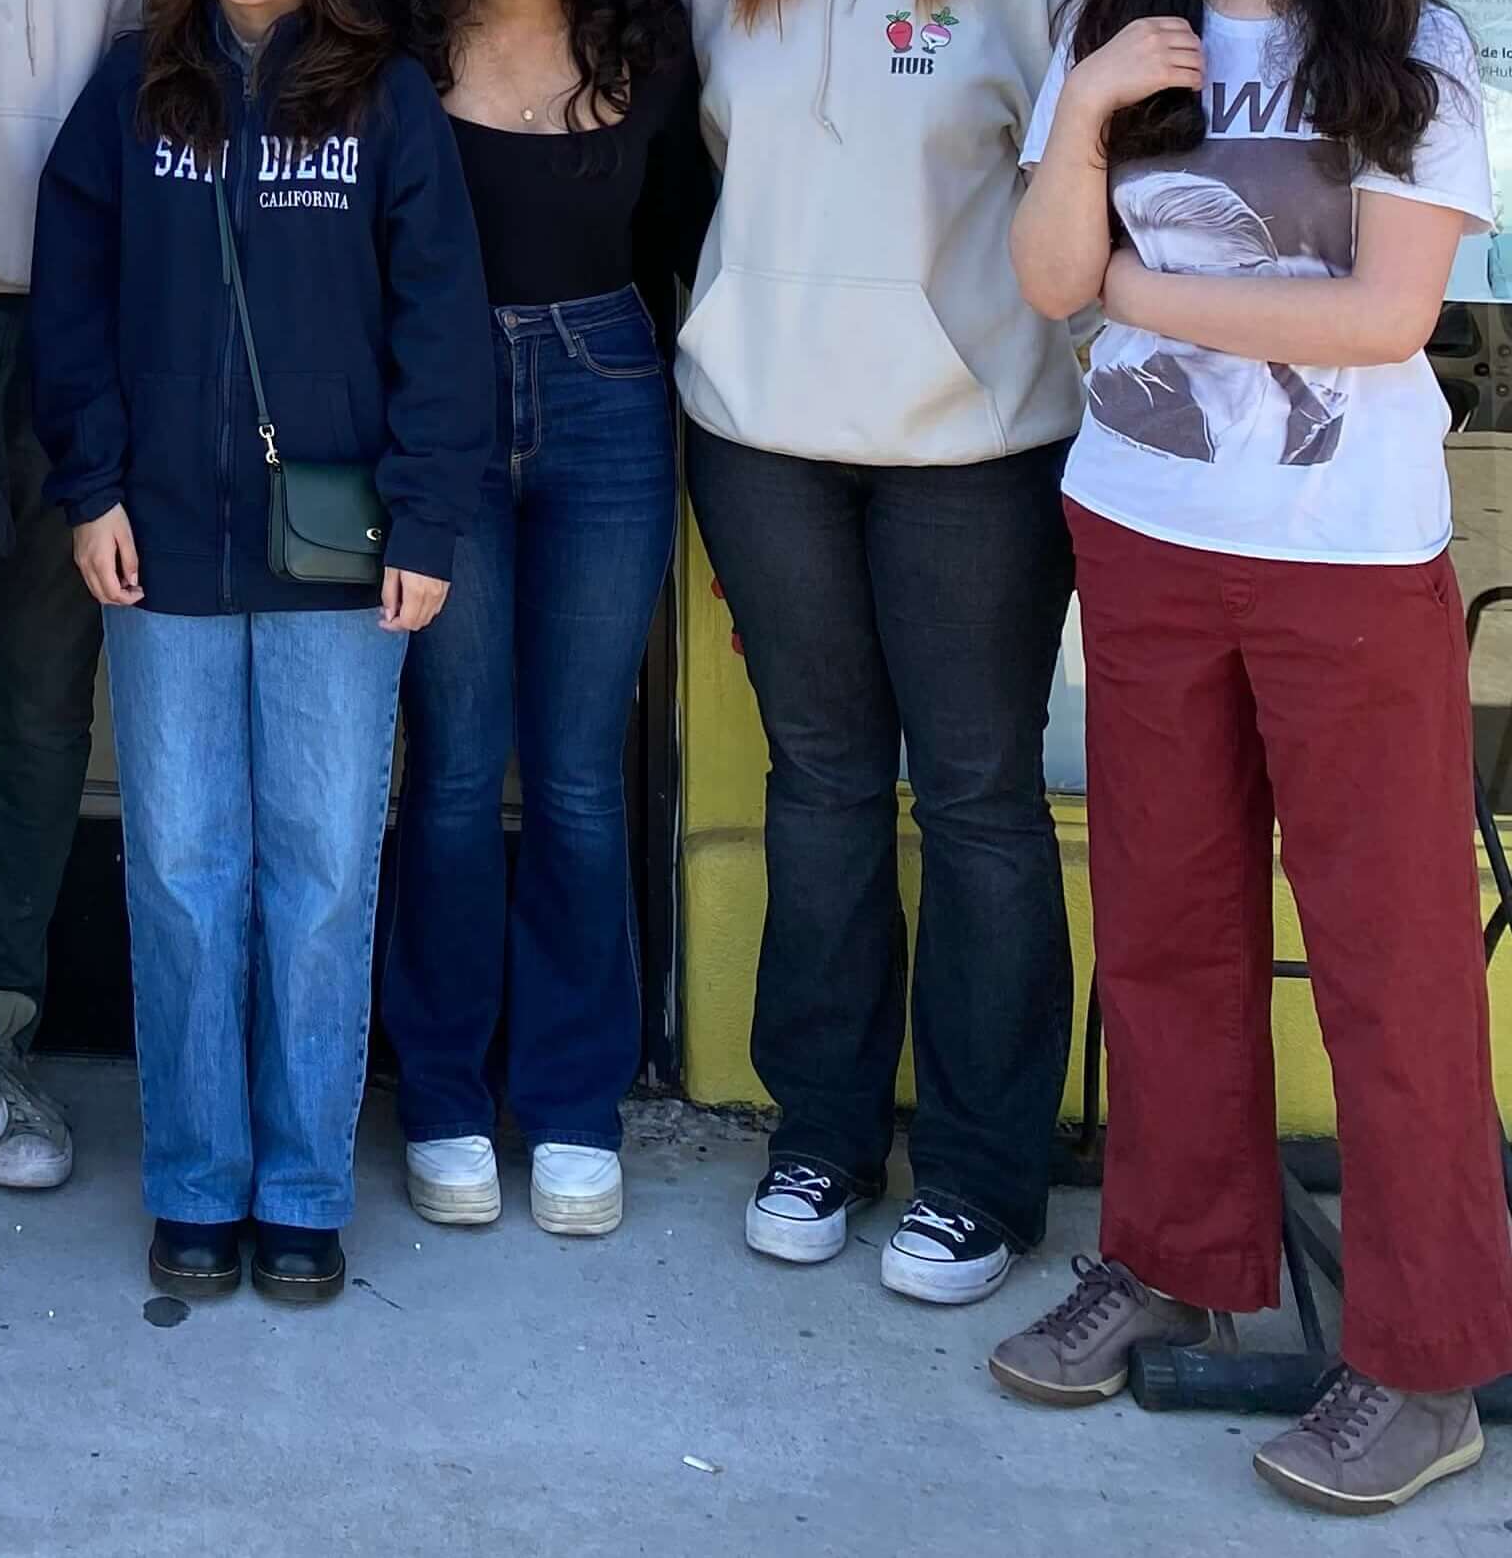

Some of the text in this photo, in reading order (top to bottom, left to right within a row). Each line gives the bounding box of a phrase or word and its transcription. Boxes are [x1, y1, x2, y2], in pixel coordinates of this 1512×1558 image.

[1480, 47, 1498, 59] de
[890, 56, 934, 74] HUB
[258, 135, 359, 184] DIEGO
[259, 190, 349, 210] CALIFORNIA
